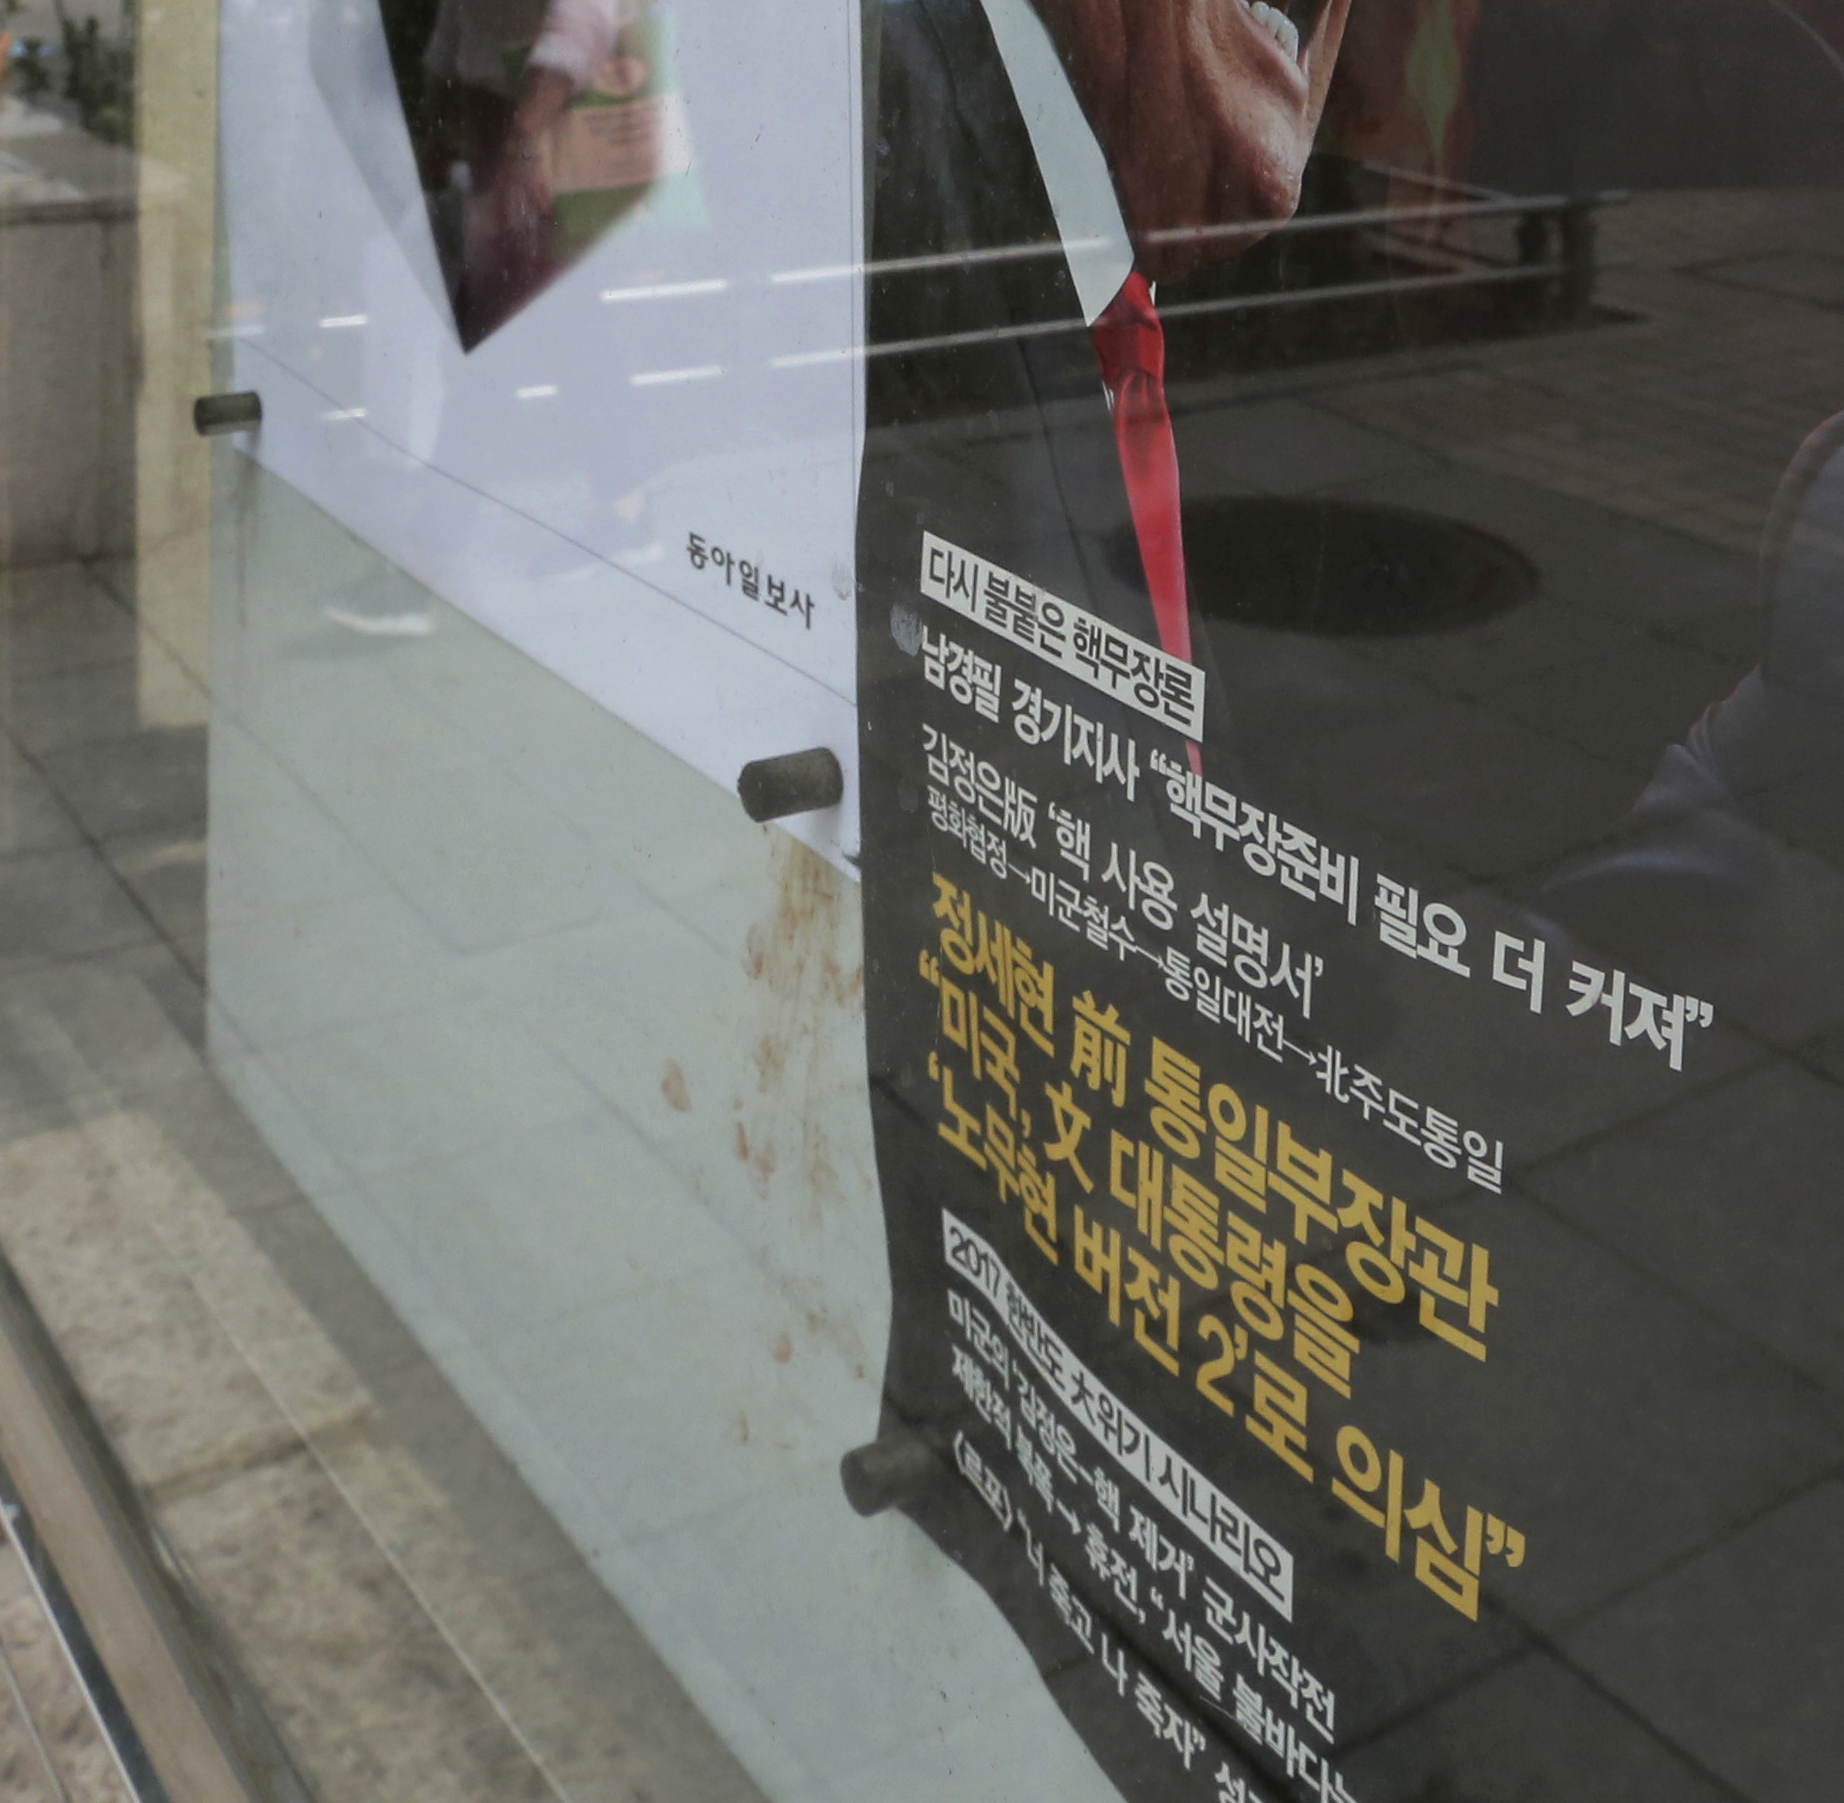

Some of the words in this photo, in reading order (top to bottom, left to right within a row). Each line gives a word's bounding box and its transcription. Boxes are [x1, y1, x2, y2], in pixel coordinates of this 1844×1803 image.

[686, 531, 815, 631] 동아일보사
[930, 546, 979, 613] 다시
[984, 571, 1066, 658] 불붙은
[1073, 616, 1195, 728] 핵무장론
[921, 624, 1002, 724] 남경필
[1012, 678, 1140, 802] 경기지사
[1149, 749, 1359, 926] “핵무장준비
[1374, 873, 1471, 979] 필요
[1492, 930, 1546, 1014] 더
[1565, 960, 1714, 1071] 커져”
[922, 723, 1038, 850] 김정은版
[1047, 801, 1091, 882] ‘핵
[1101, 841, 1178, 930] 사용
[1190, 892, 1323, 1020] 설명서’
[918, 949, 1032, 1140] “미국,
[1044, 1081, 1093, 1195] 文
[1109, 1128, 1361, 1401] 대통령을
[932, 871, 1057, 1057] 정세현
[1070, 989, 1131, 1108] 前
[1144, 1036, 1501, 1362] 통일부장관
[928, 1050, 1059, 1267] ‘노무현
[1072, 1203, 1181, 1378] 버전
[1331, 1424, 1527, 1622] 의심”
[947, 1288, 1010, 1391] 미군의
[1202, 1576, 1335, 1745] 군사작전
[950, 1226, 1001, 1298] 2017
[1006, 1272, 1066, 1391] 한반도
[1070, 1369, 1151, 1483] 大위기
[1158, 1454, 1287, 1605] 시나리오
[952, 1344, 1012, 1450] 제한적
[1084, 1522, 1146, 1625] 휴전,
[1149, 1586, 1227, 1702] “서울
[1101, 1633, 1128, 1697] 나
